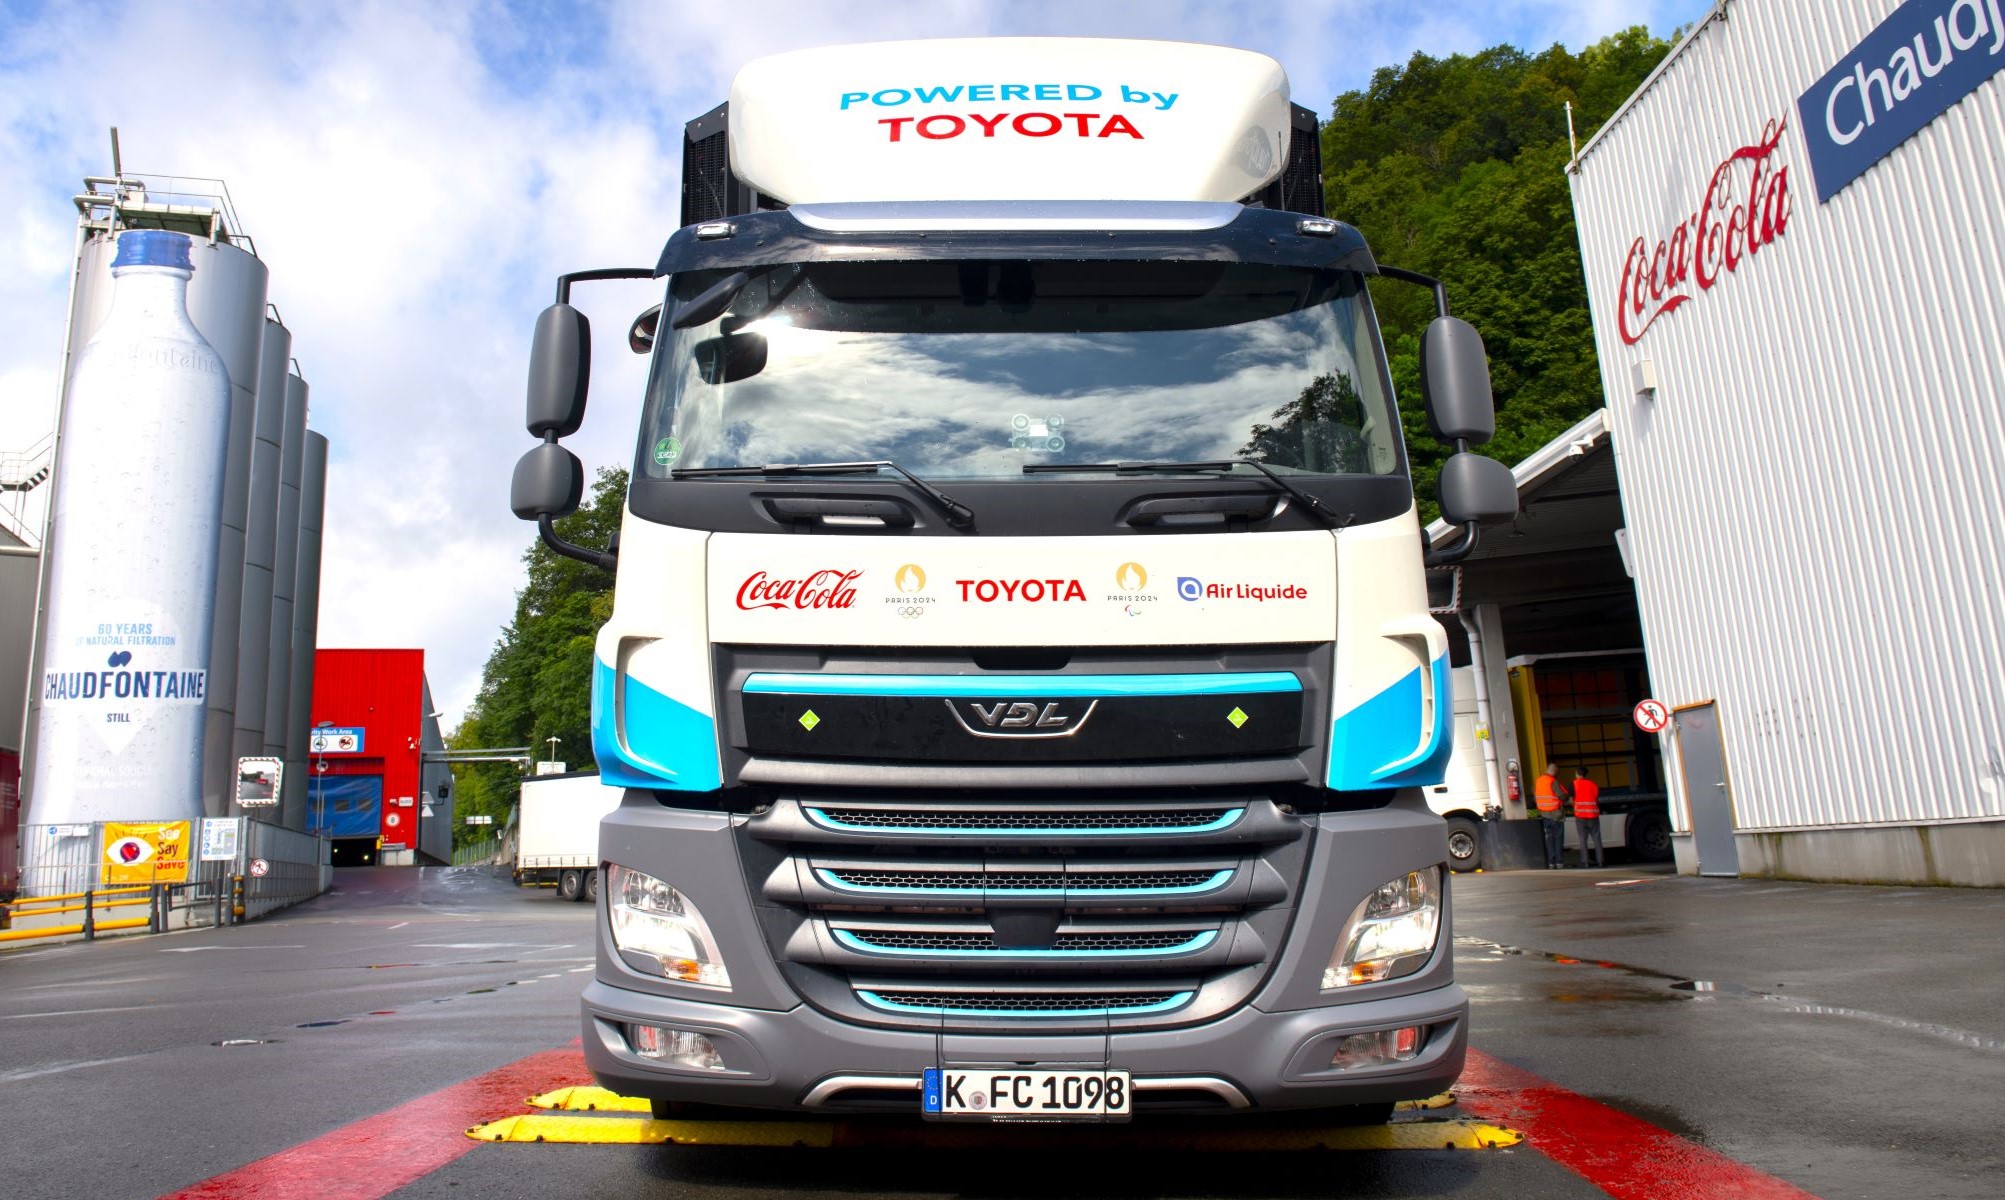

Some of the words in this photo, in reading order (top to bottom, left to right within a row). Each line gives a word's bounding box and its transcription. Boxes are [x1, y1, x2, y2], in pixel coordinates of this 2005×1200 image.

[840, 84, 1102, 110] POWERED
[1120, 85, 1180, 111] by
[878, 112, 1145, 142] TOYOTA
[956, 579, 1087, 602] TOYOTA
[1206, 582, 1233, 599] Air
[1237, 582, 1308, 602] Liquide
[98, 623, 112, 635] 60
[116, 623, 153, 635] YEARS
[86, 635, 124, 646] NATURAL
[127, 635, 176, 646] FILTRATION
[45, 671, 204, 700] CHAUDFONTAINE
[106, 713, 131, 723] STILL
[970, 702, 1069, 727] VDL
[158, 826, 180, 840] See
[157, 841, 179, 858] Say
[929, 1095, 938, 1105] D
[946, 1075, 967, 1108] K
[990, 1075, 1034, 1109] FC
[1042, 1075, 1124, 1109] 1098
